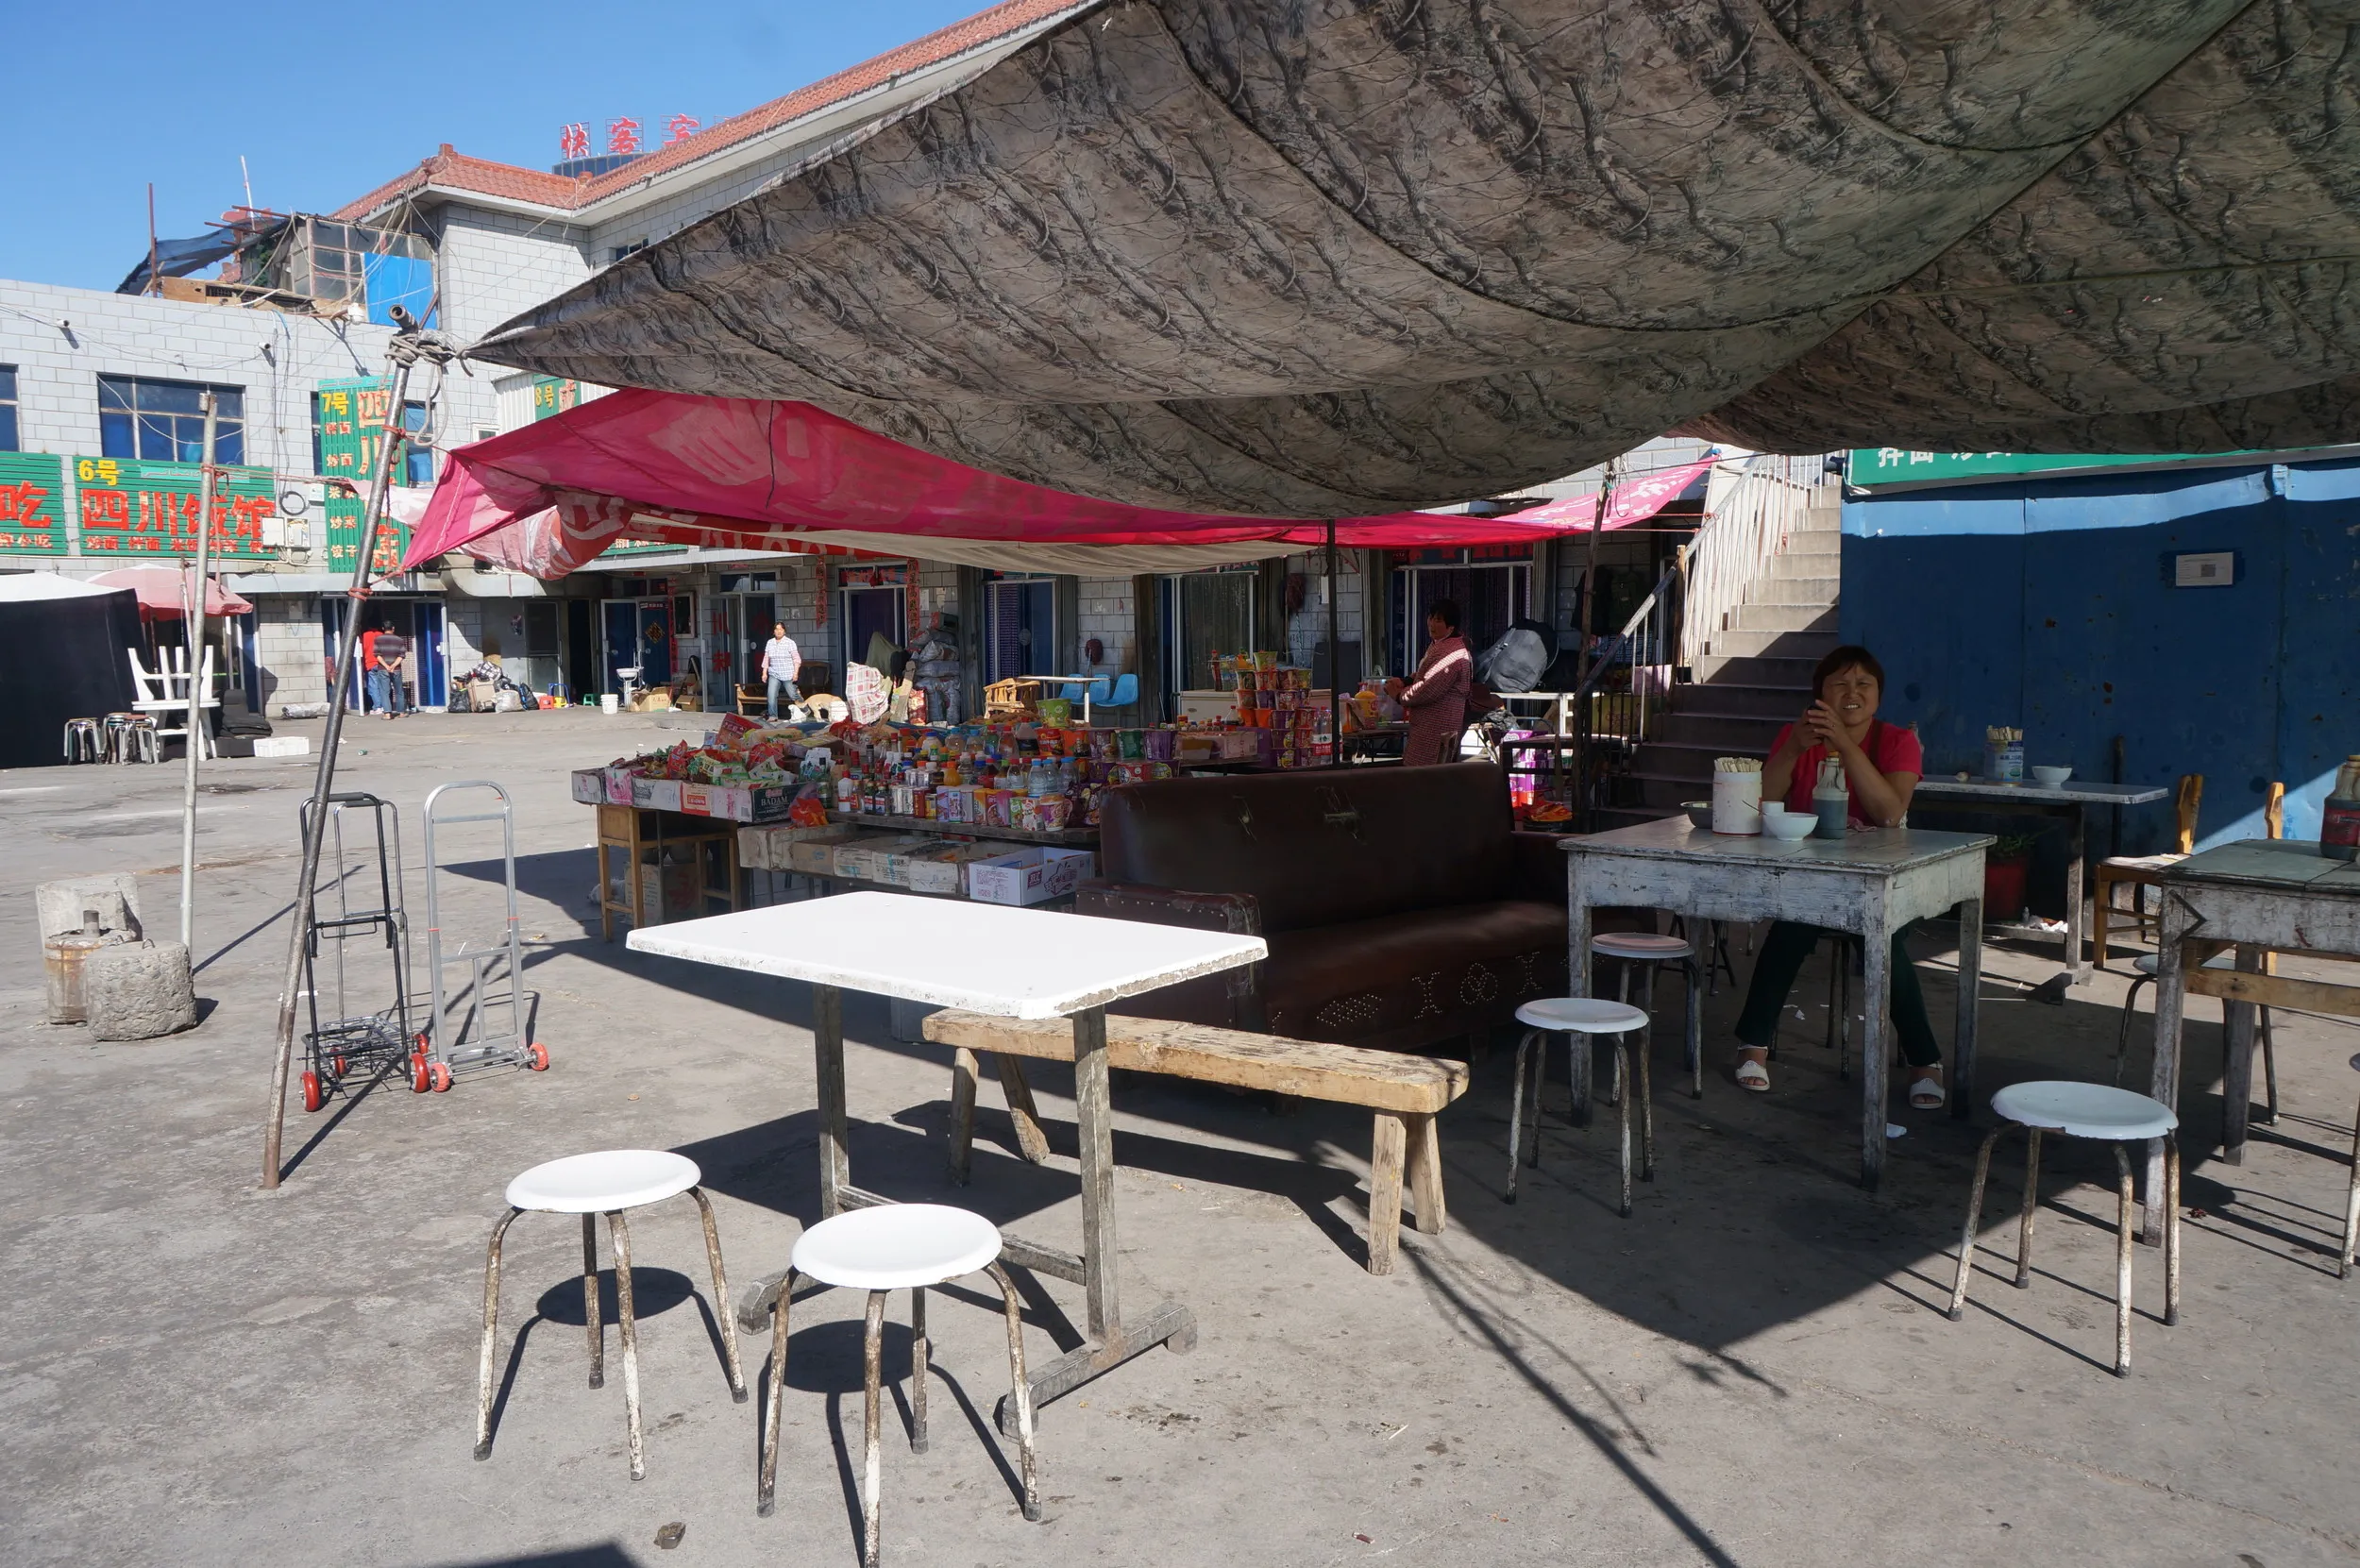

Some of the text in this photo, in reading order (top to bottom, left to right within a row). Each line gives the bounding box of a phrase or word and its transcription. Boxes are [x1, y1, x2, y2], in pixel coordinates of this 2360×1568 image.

[322, 392, 349, 415] 7号
[535, 385, 554, 409] 8号
[79, 460, 119, 486] 6号
[81, 488, 276, 539] 四川饭馆
[761, 796, 788, 806] BADAM
